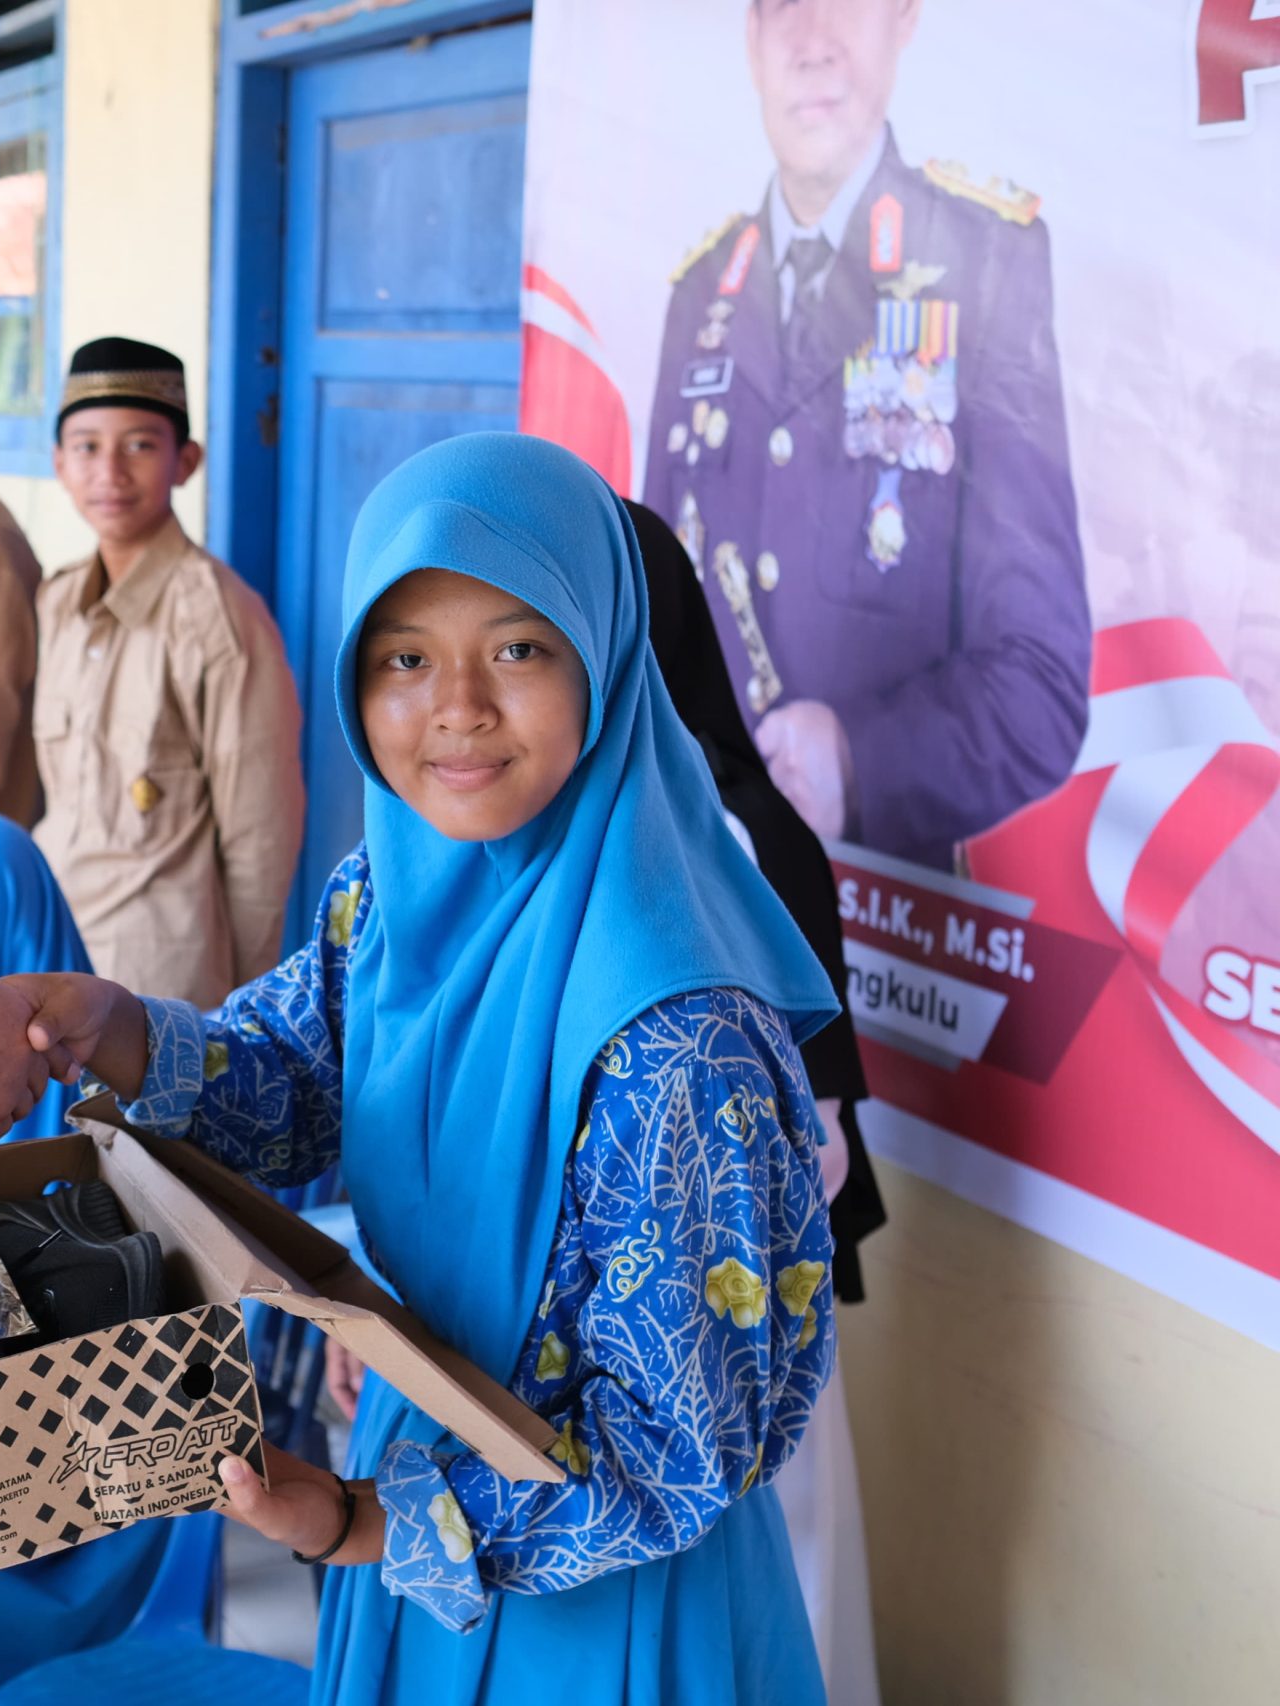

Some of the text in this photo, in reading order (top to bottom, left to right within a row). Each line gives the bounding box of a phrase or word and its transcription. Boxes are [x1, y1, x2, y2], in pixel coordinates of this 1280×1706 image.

[838, 878, 1034, 983] S.I.K., M.Si.
[94, 1463, 210, 1498] SEPATU & SANDAL
[94, 1485, 217, 1522] BUATAN INDONESIA
